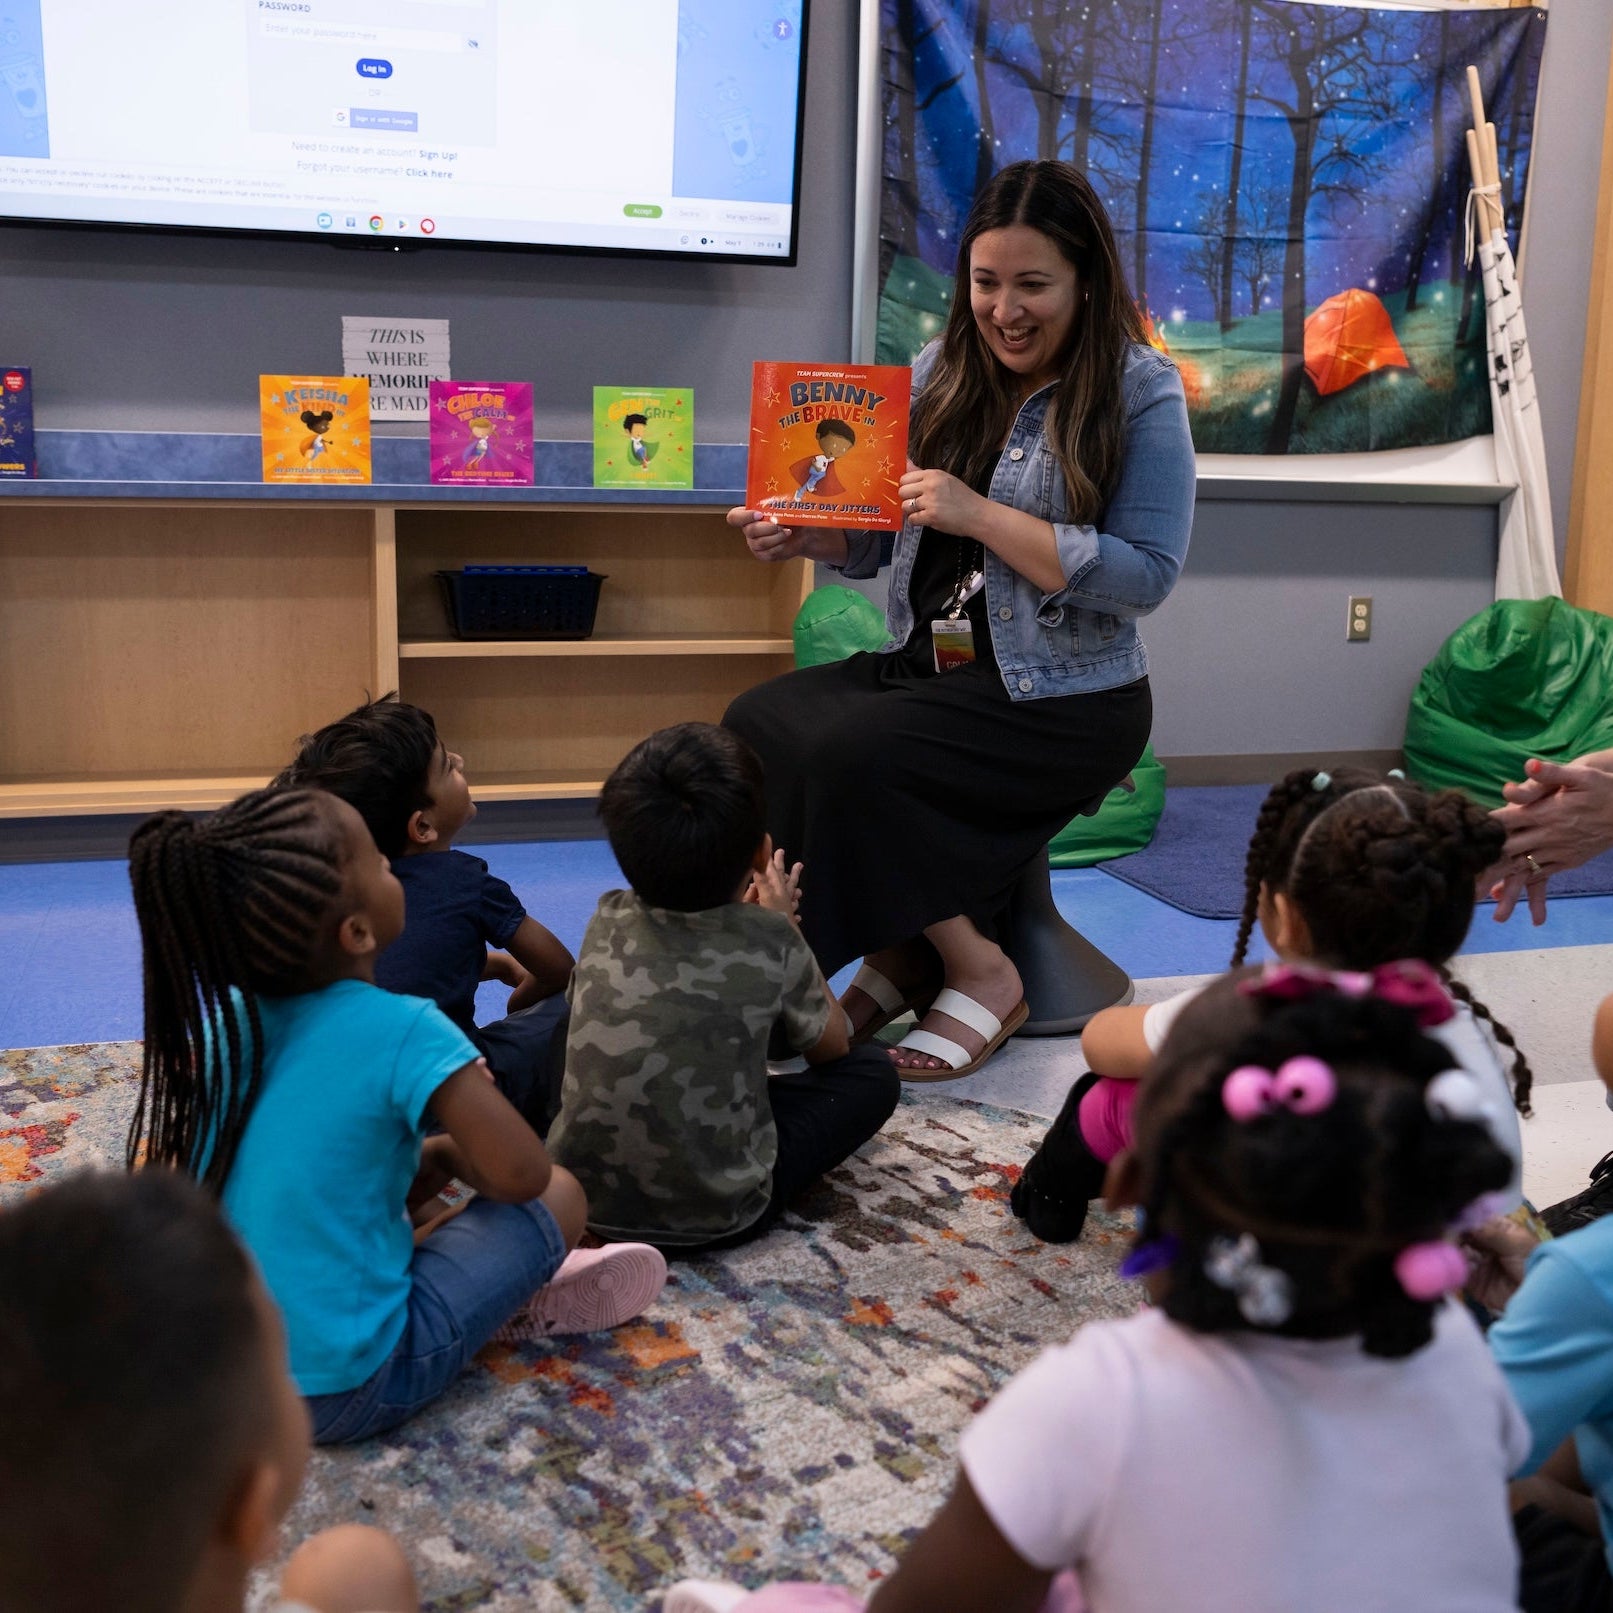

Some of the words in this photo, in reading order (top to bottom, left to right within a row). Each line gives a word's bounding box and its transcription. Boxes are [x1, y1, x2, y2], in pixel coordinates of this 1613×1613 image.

[258, 0, 311, 13] PASSWORD
[363, 64, 377, 74] Log
[378, 65, 387, 73] in
[292, 142, 316, 151] Need
[319, 143, 328, 152] to
[331, 144, 361, 154] create
[363, 147, 374, 155] an
[376, 146, 416, 157] account?
[419, 149, 439, 161] Sign
[441, 152, 458, 164] Up!
[297, 160, 327, 172] Forgot
[329, 163, 350, 174] your
[353, 165, 402, 176] username?
[405, 167, 427, 177] Click
[431, 169, 453, 178] here
[632, 207, 653, 215] Accept
[370, 329, 407, 344] THIS
[410, 329, 425, 344] IS
[366, 351, 429, 367] WHERE
[797, 370, 812, 378] TEAM
[812, 371, 844, 379] SUPERCREW
[844, 373, 867, 381] presents
[284, 388, 349, 406] KEISHA
[447, 392, 506, 415] CHLOE
[790, 381, 887, 412] BENNY
[474, 407, 507, 420] CALM
[644, 408, 675, 419] GRIT
[778, 411, 801, 429] THE
[803, 405, 863, 424] BRAVE
[864, 416, 876, 426] IN
[789, 501, 817, 511] FIRST
[819, 503, 838, 512] DAY
[841, 504, 881, 515] JITTERS
